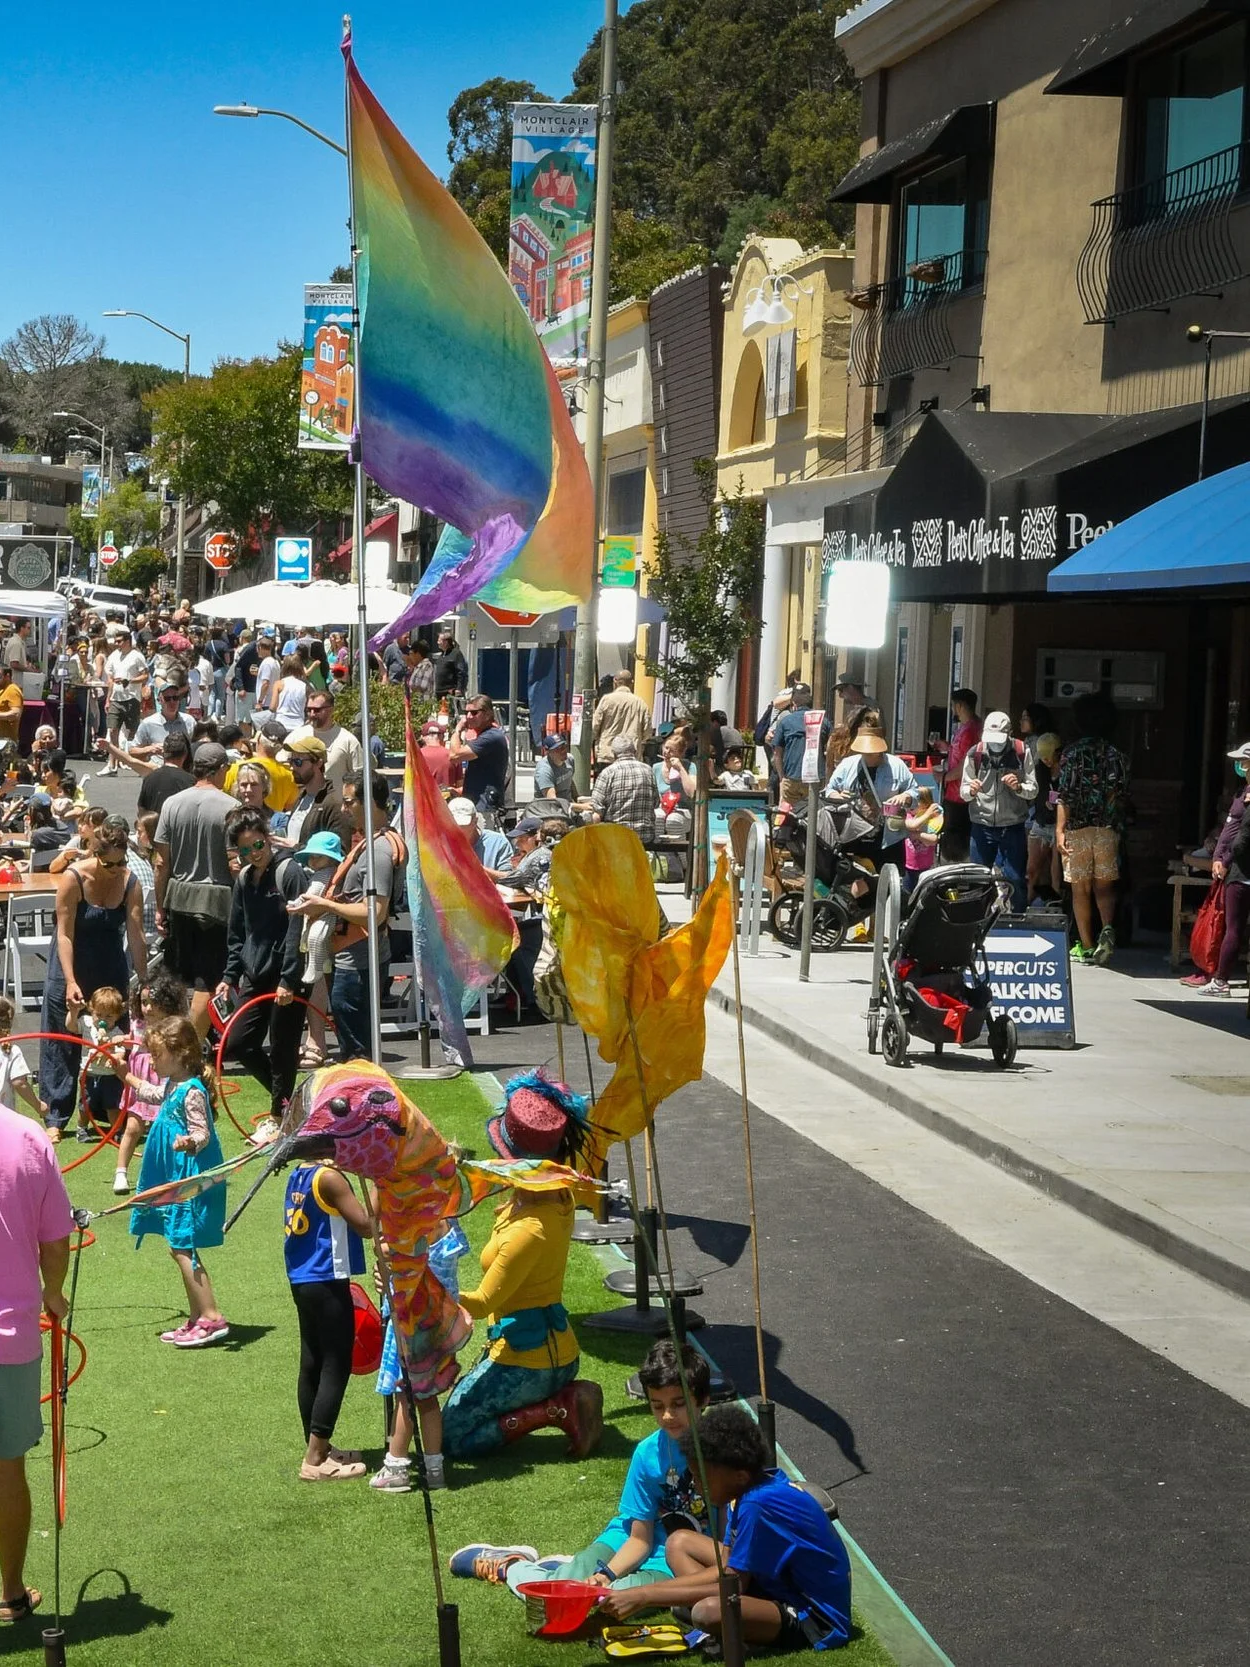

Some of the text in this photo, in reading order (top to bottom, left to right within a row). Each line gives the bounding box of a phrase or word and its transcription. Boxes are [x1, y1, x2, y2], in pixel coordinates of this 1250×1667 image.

[520, 116, 589, 126] MONTCLAIR
[525, 125, 584, 134] VILLAGE
[893, 528, 906, 567] Tea
[946, 516, 1015, 565] Peet's Coffee & Tea
